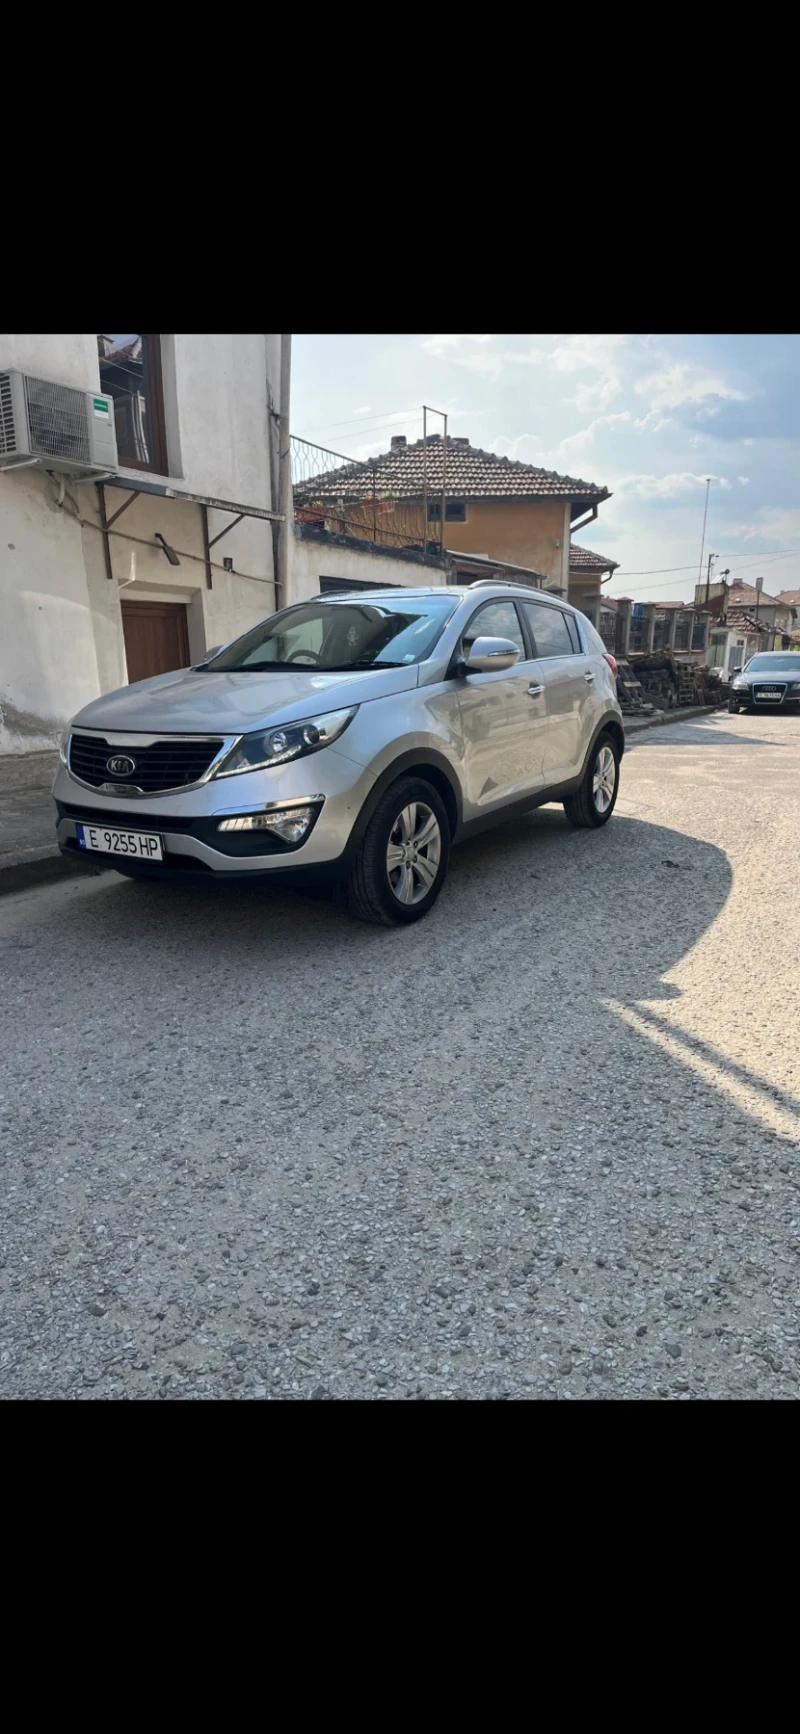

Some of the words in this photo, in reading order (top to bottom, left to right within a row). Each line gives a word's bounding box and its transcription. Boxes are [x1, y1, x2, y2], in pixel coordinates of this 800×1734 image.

[110, 760, 129, 772] KIA
[89, 829, 99, 848] E
[104, 832, 137, 854] 9255
[139, 836, 158, 857] HP
